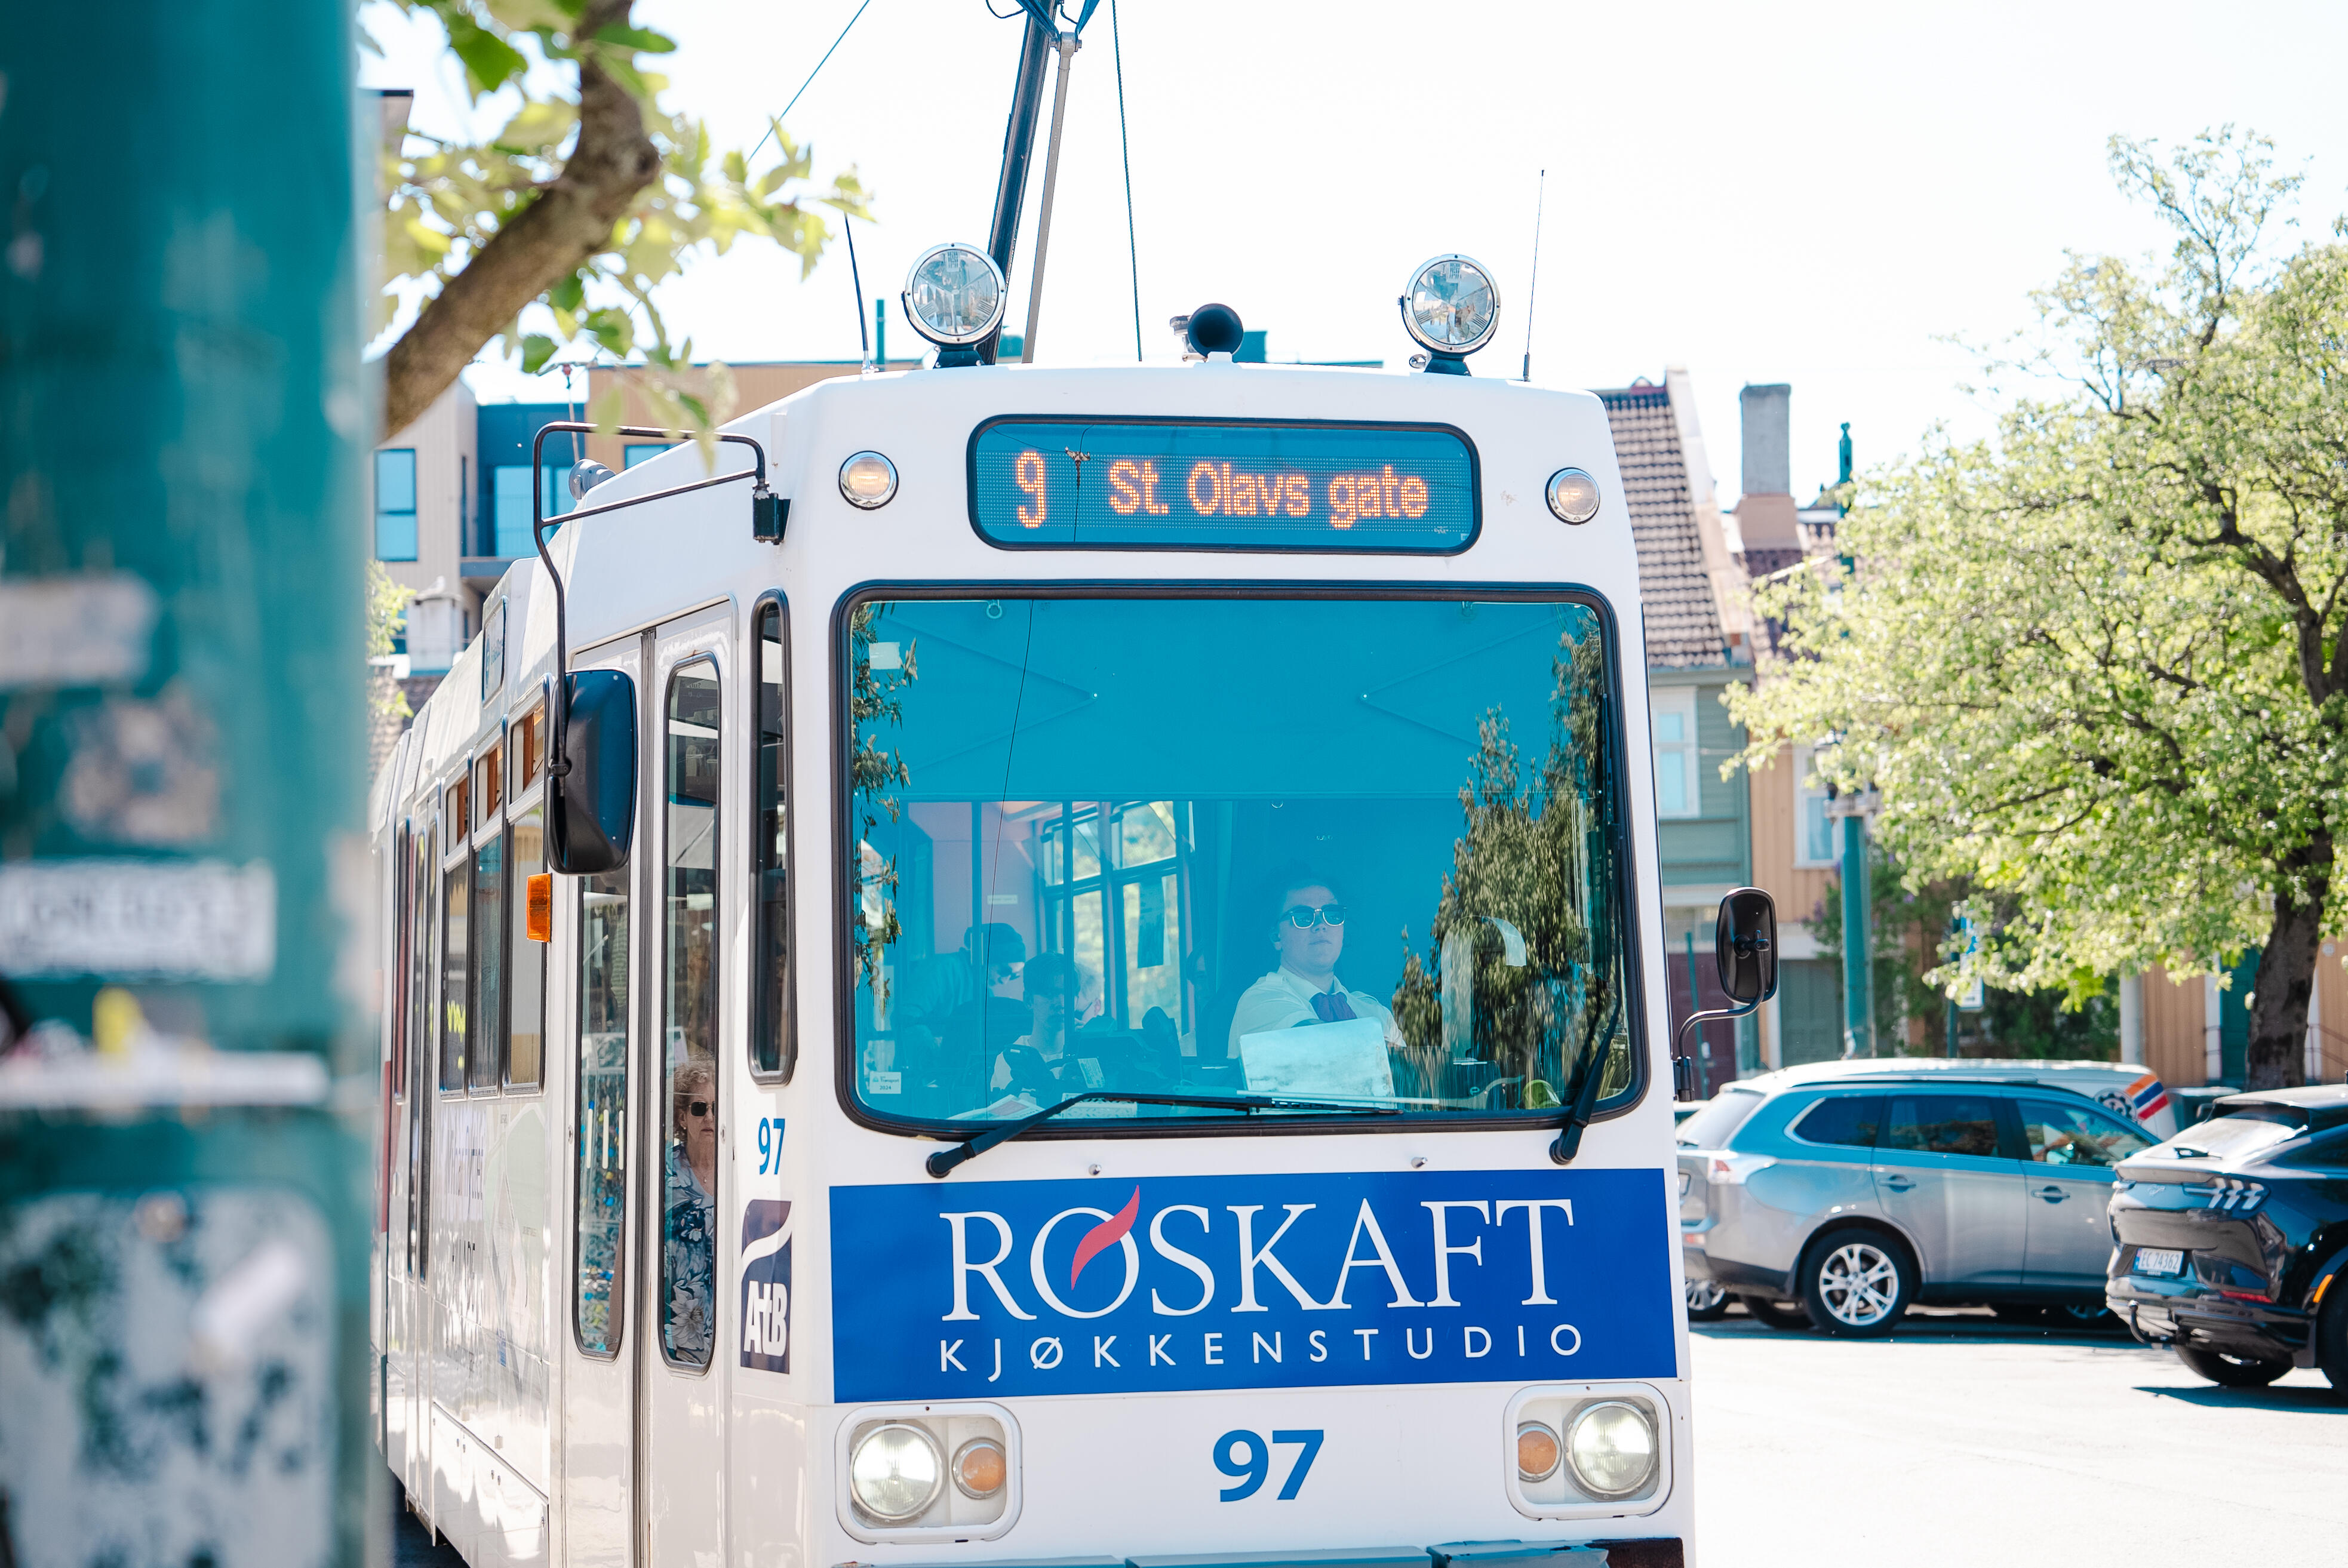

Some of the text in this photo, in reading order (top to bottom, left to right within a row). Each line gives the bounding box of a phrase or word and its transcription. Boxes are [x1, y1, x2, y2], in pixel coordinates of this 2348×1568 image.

[1016, 451, 1429, 528] 9 St. Olavs gate
[758, 1117, 786, 1175] 97
[2141, 1251, 2180, 1269] EC 74362
[941, 1324, 1582, 1383] KJØKKENSTUDIO
[1212, 1429, 1324, 1503] 97
